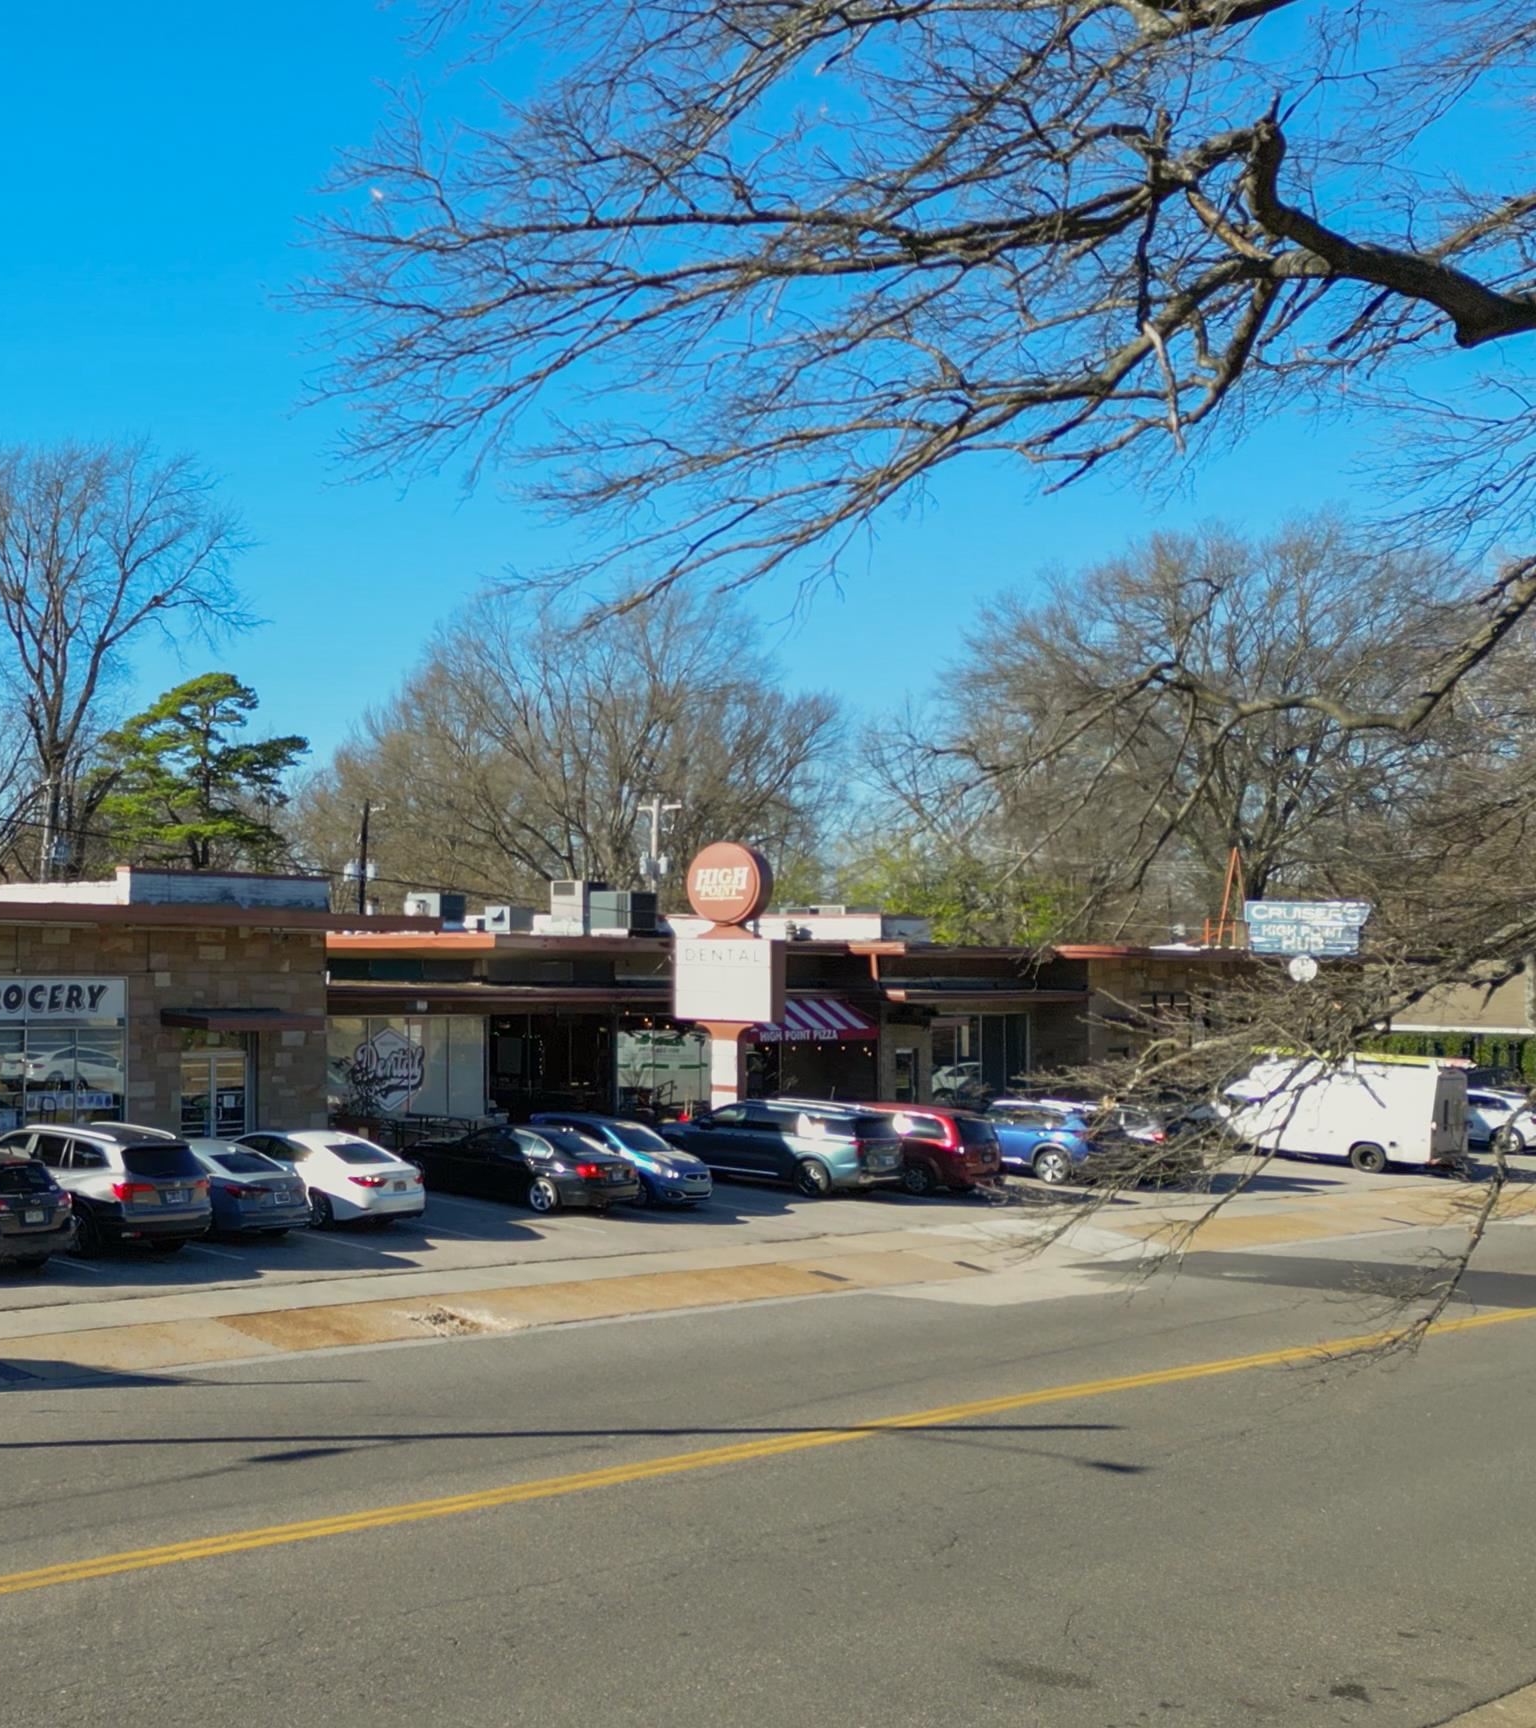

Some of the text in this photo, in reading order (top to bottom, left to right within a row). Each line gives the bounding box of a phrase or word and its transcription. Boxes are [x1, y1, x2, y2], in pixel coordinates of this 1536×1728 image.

[695, 867, 749, 891] HIGH
[700, 885, 737, 896] POINT
[685, 948, 760, 962] DENTAL
[760, 1031, 782, 1042] HIGH
[785, 1030, 810, 1041] POINT
